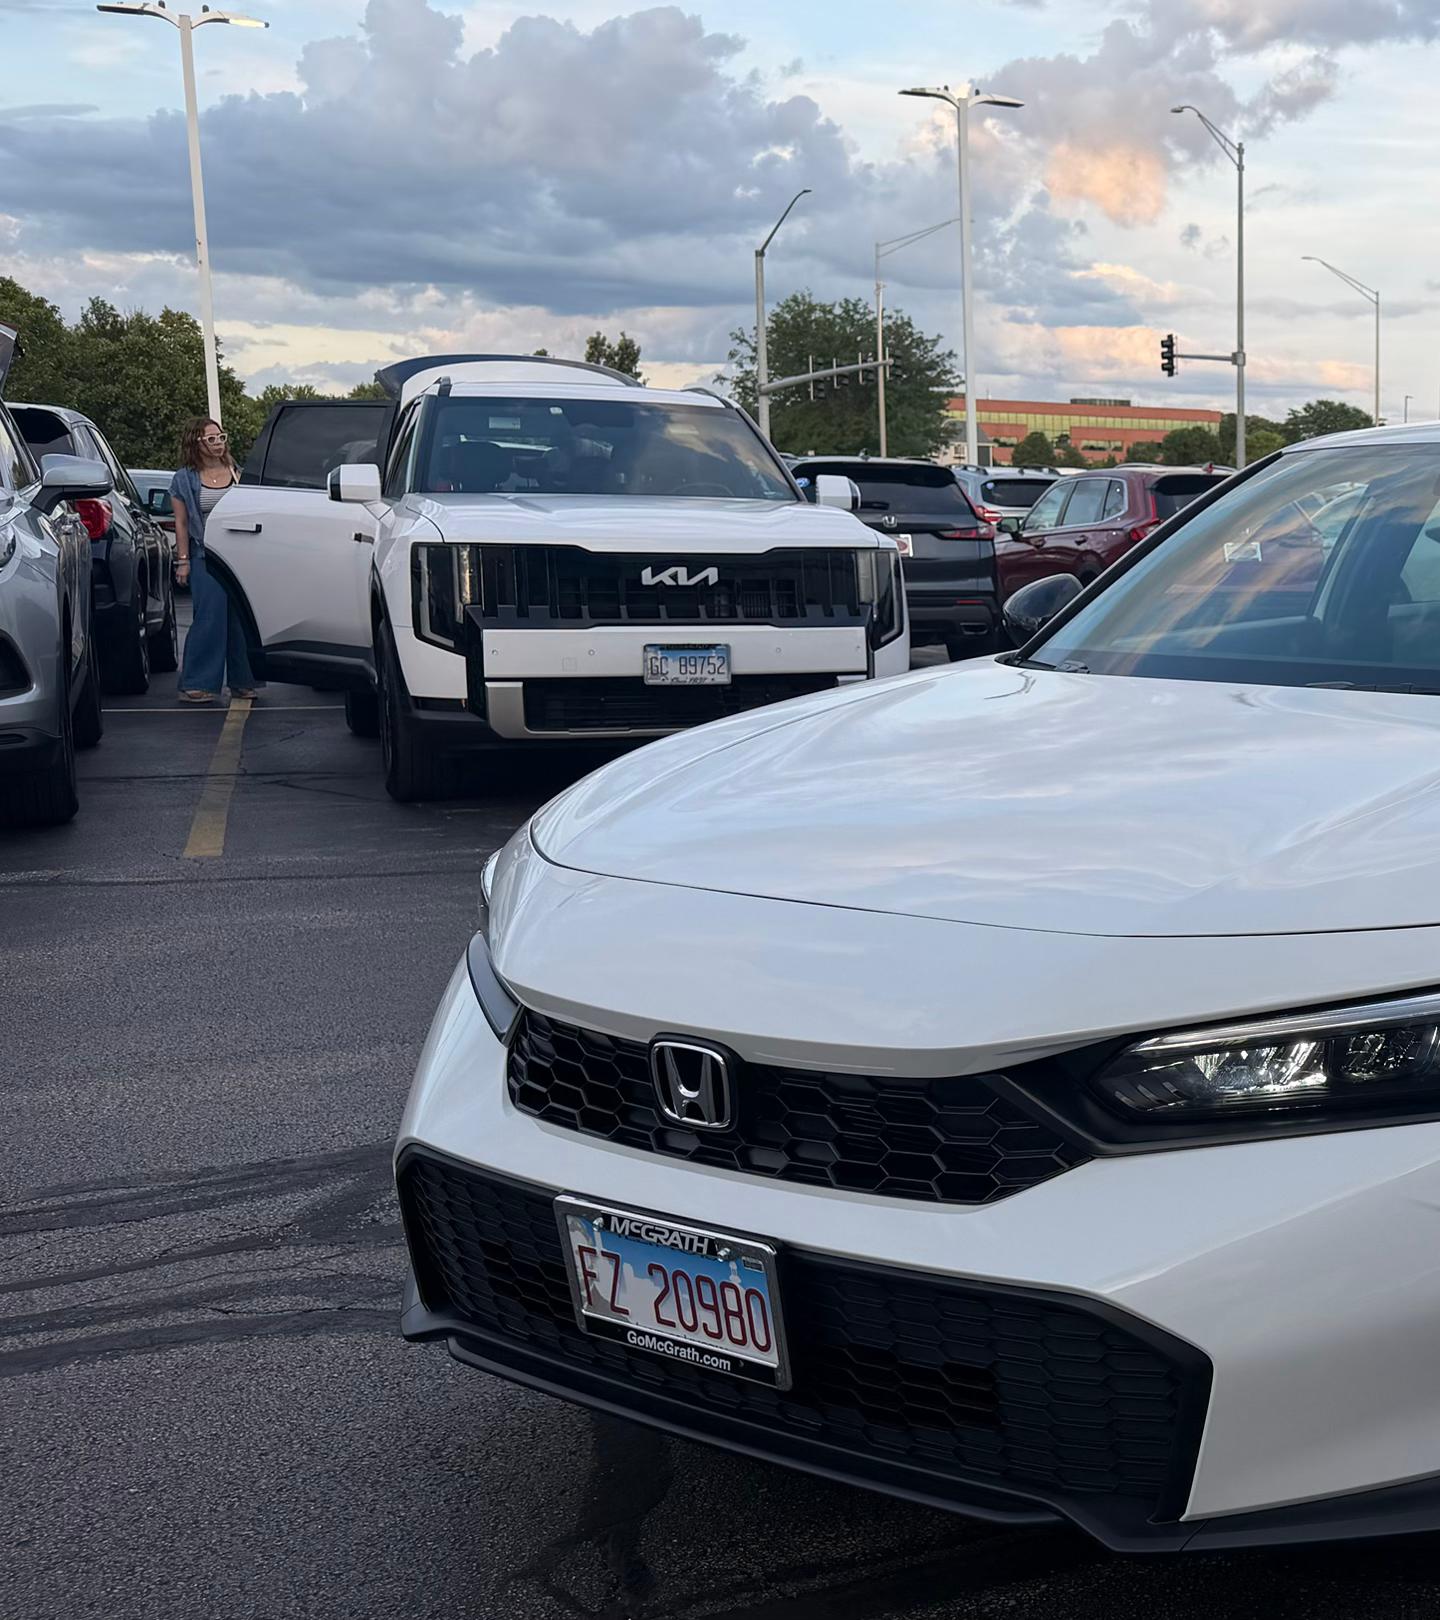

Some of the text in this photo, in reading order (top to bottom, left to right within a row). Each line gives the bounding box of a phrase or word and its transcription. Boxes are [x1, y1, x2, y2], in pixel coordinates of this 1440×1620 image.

[641, 566, 718, 586] KIA
[650, 656, 726, 675] GC 89752
[578, 1245, 772, 1353] FZ 20980
[627, 1331, 731, 1371] GoMcGrath.com
